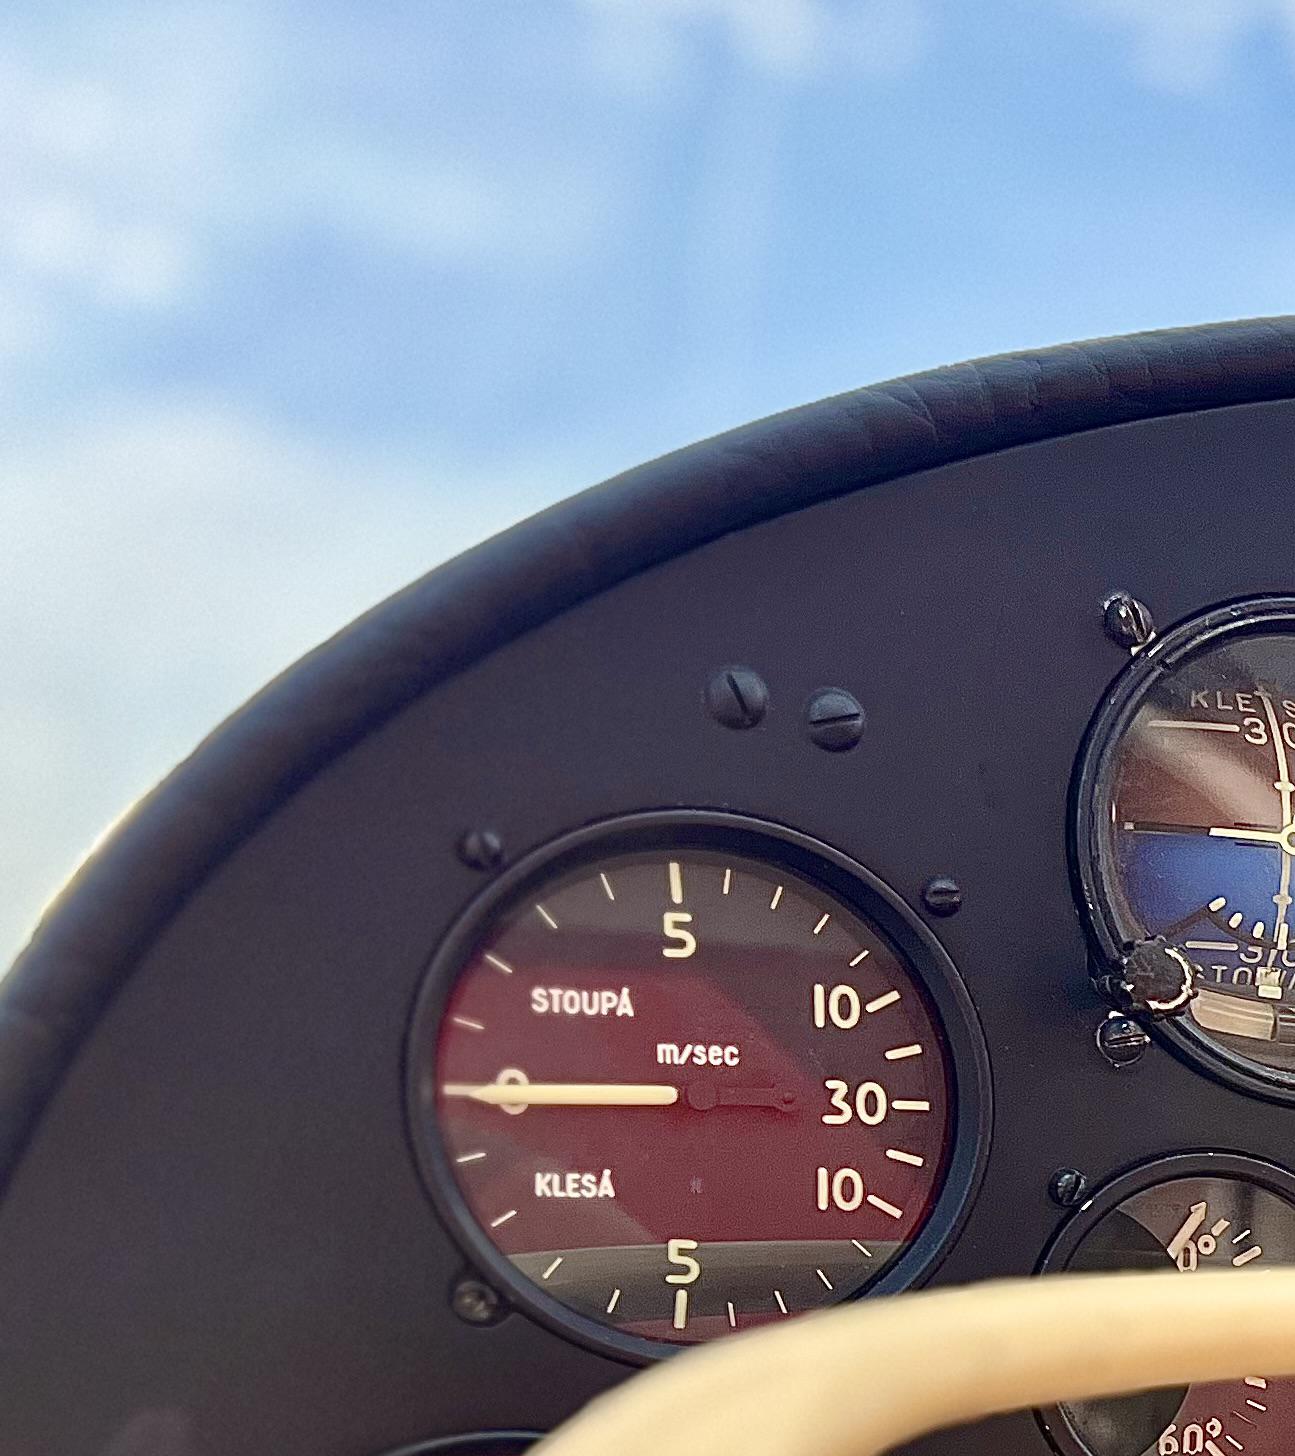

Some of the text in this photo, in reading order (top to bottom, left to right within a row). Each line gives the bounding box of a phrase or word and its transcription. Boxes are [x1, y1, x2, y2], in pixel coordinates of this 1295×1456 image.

[661, 911, 697, 959] 5
[530, 986, 635, 1018] STOUPÁ
[813, 982, 862, 1029] 10
[656, 1041, 741, 1067] m/sec
[821, 1078, 888, 1126] 30
[533, 1168, 616, 1199] KLESÁ
[816, 1166, 865, 1212] 10
[664, 1238, 701, 1285] 5
